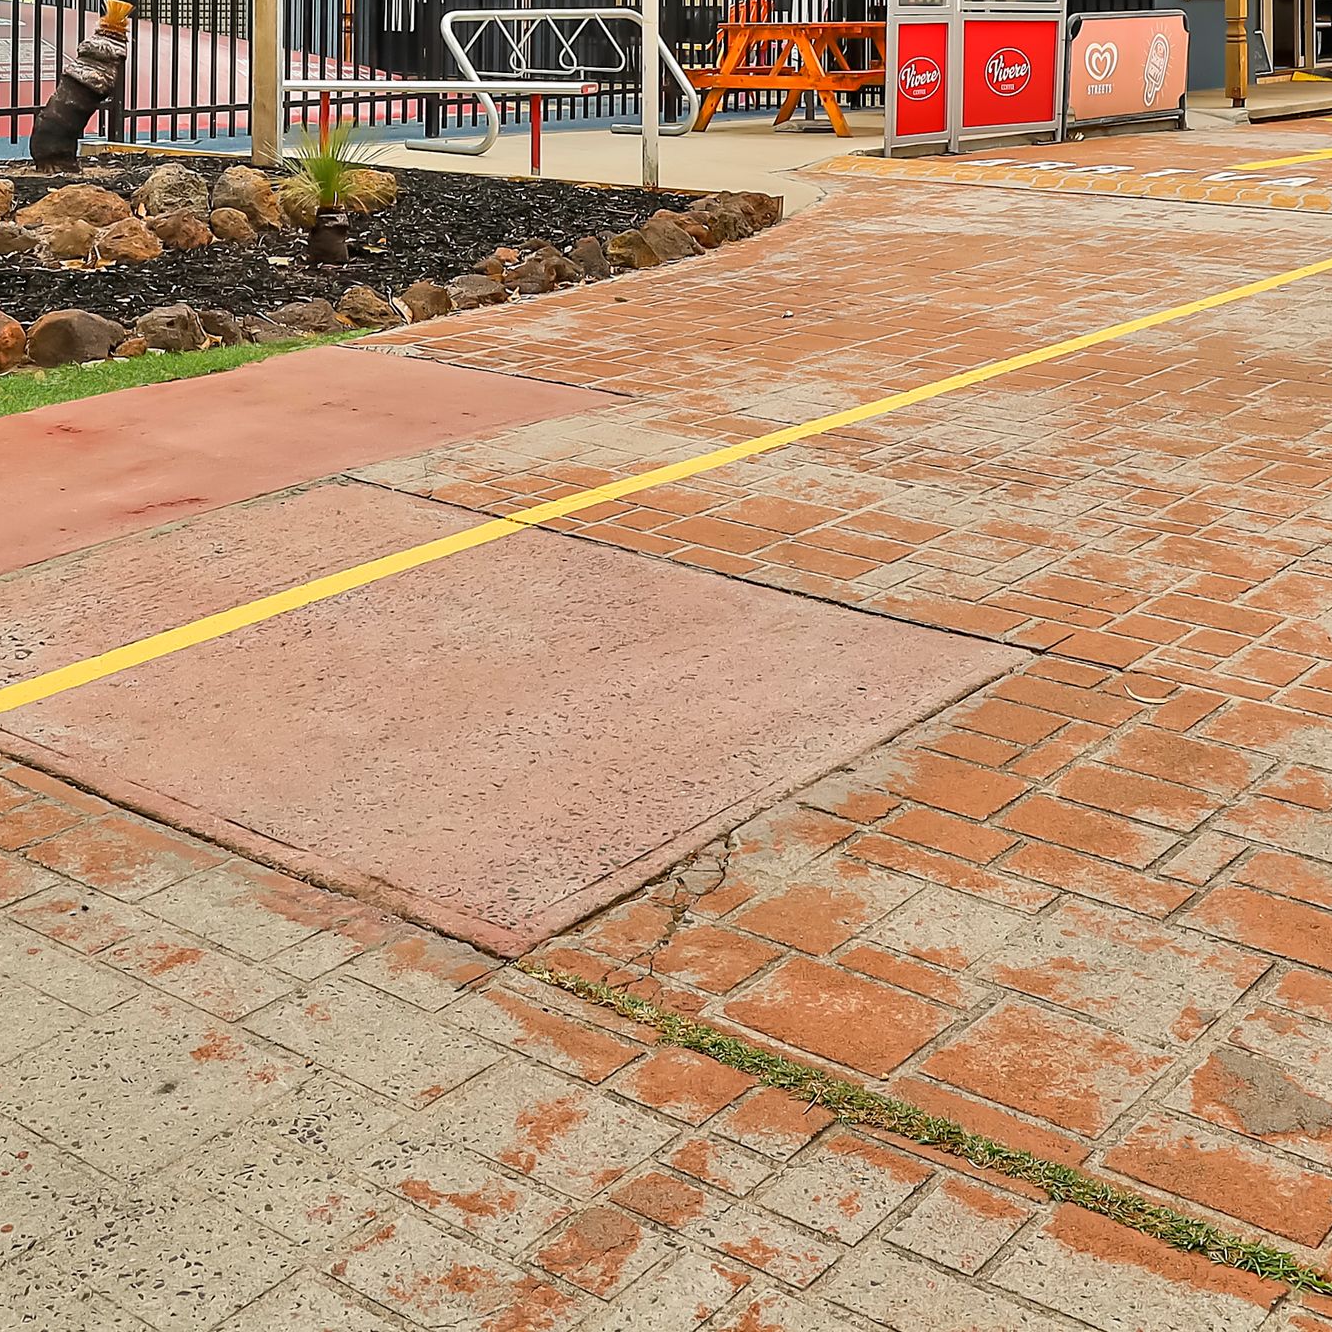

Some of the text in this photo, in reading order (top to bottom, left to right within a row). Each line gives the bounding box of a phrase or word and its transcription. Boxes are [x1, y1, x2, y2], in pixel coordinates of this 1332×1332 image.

[901, 63, 939, 89] Vivere
[988, 55, 1029, 83] Vivere
[1087, 84, 1112, 95] STREETS
